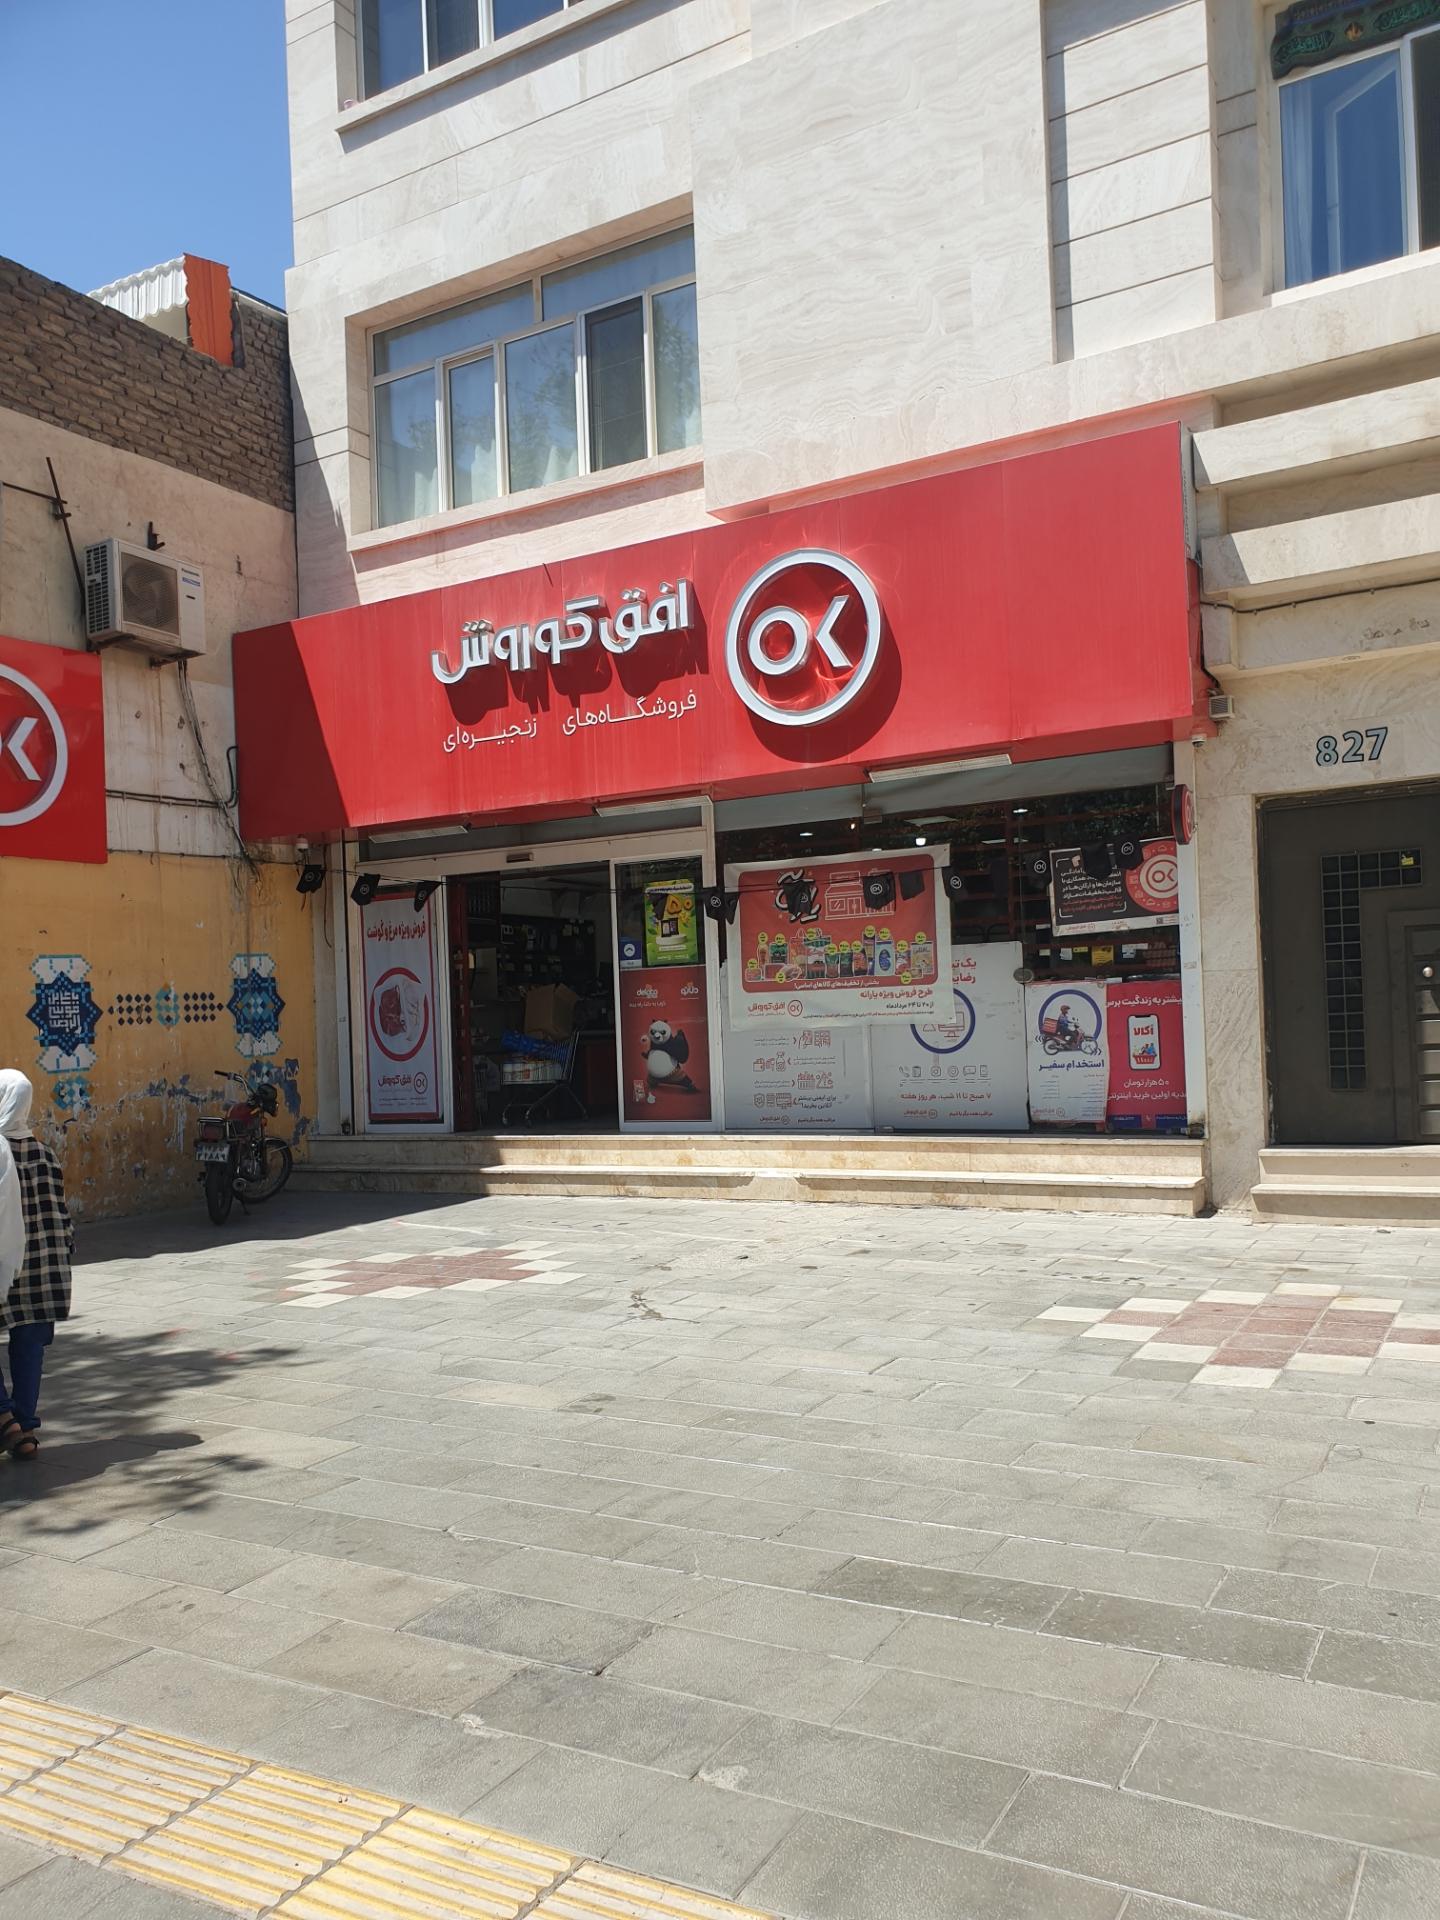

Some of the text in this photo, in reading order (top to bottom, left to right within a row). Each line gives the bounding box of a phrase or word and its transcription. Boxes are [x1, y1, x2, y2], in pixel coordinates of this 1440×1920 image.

[432, 578, 692, 684] افق کوروش
[748, 595, 854, 676] OK
[1316, 726, 1388, 767] 827
[961, 957, 977, 969] یک
[895, 988, 917, 999] فروش
[917, 988, 933, 998] طرح
[1039, 1059, 1105, 1071] استخدام سفیر
